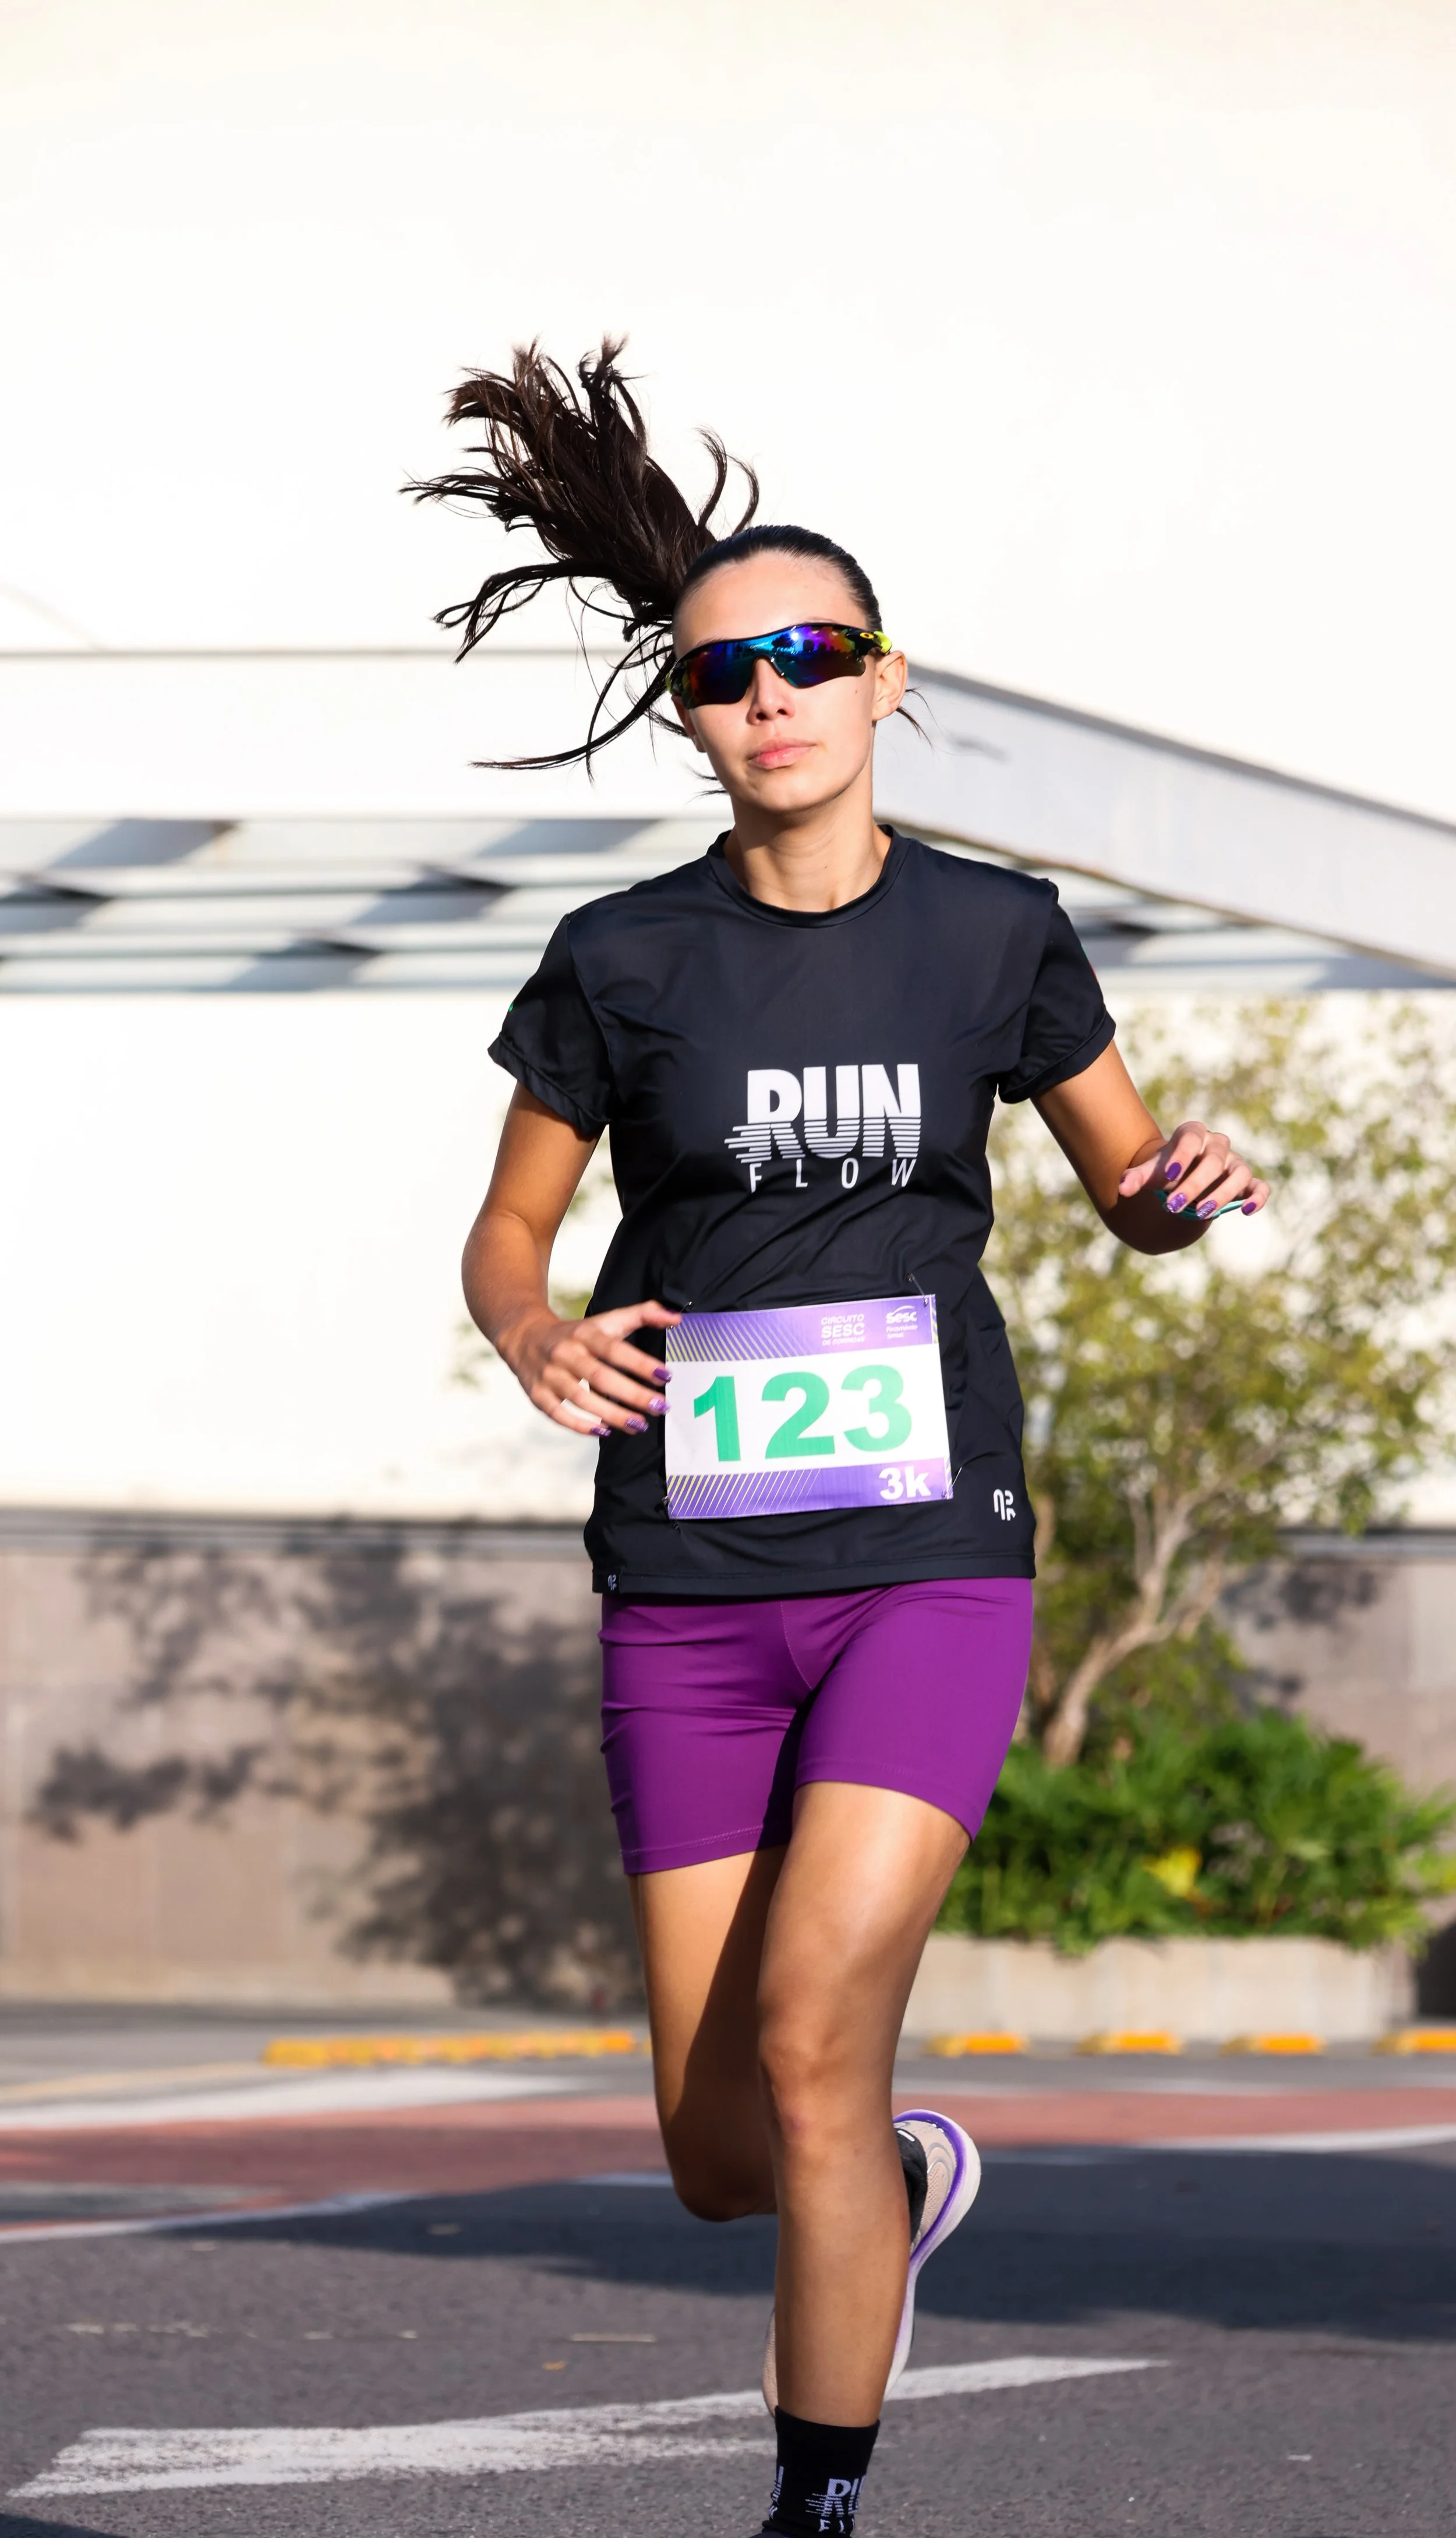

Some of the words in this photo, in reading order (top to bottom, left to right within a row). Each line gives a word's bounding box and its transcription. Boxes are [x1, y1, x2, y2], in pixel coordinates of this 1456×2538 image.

[725, 1064, 921, 1163] RUN
[749, 1157, 917, 1194] FLOW
[821, 1314, 865, 1325] CIRCUITO
[821, 1322, 865, 1339] SESC
[694, 1364, 912, 1462] 123
[805, 2475, 866, 2518] RU
